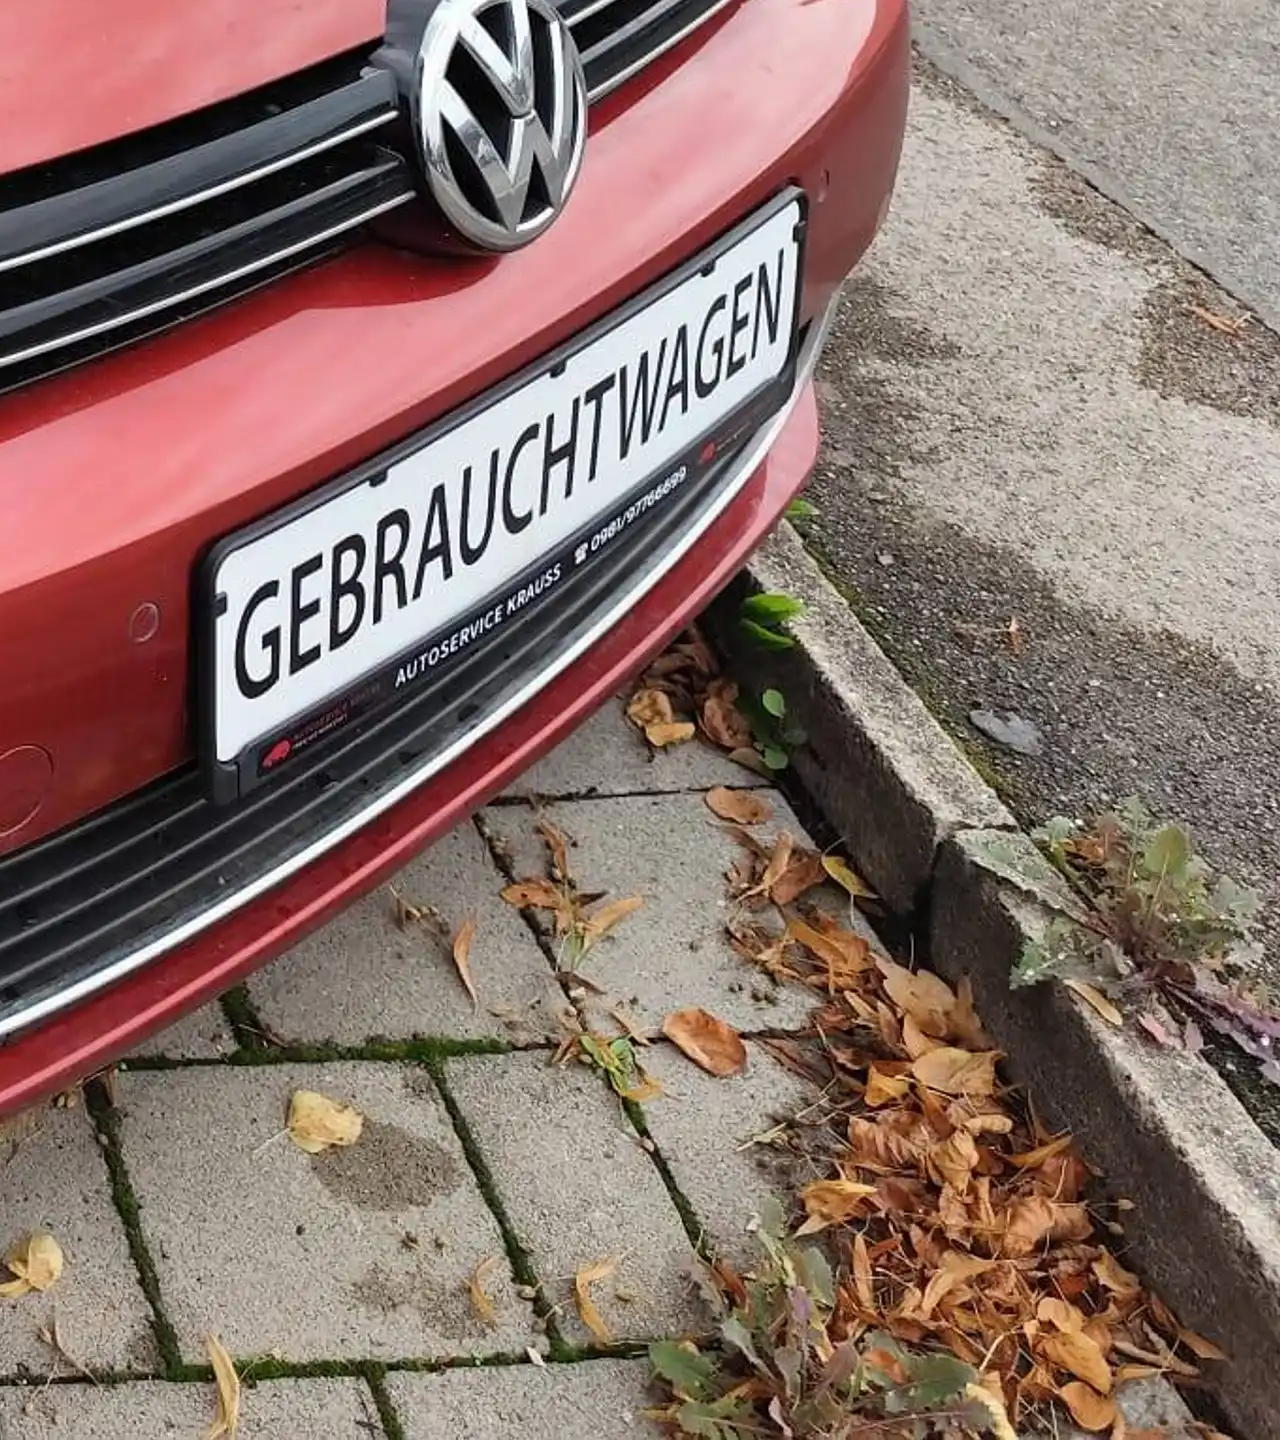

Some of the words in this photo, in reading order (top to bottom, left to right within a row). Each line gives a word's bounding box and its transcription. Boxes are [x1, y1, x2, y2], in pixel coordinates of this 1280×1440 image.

[234, 249, 785, 700] GEBRAUCHTWAGEN
[395, 603, 504, 689] AUTOSERVICE
[505, 562, 562, 615] KRAUSS
